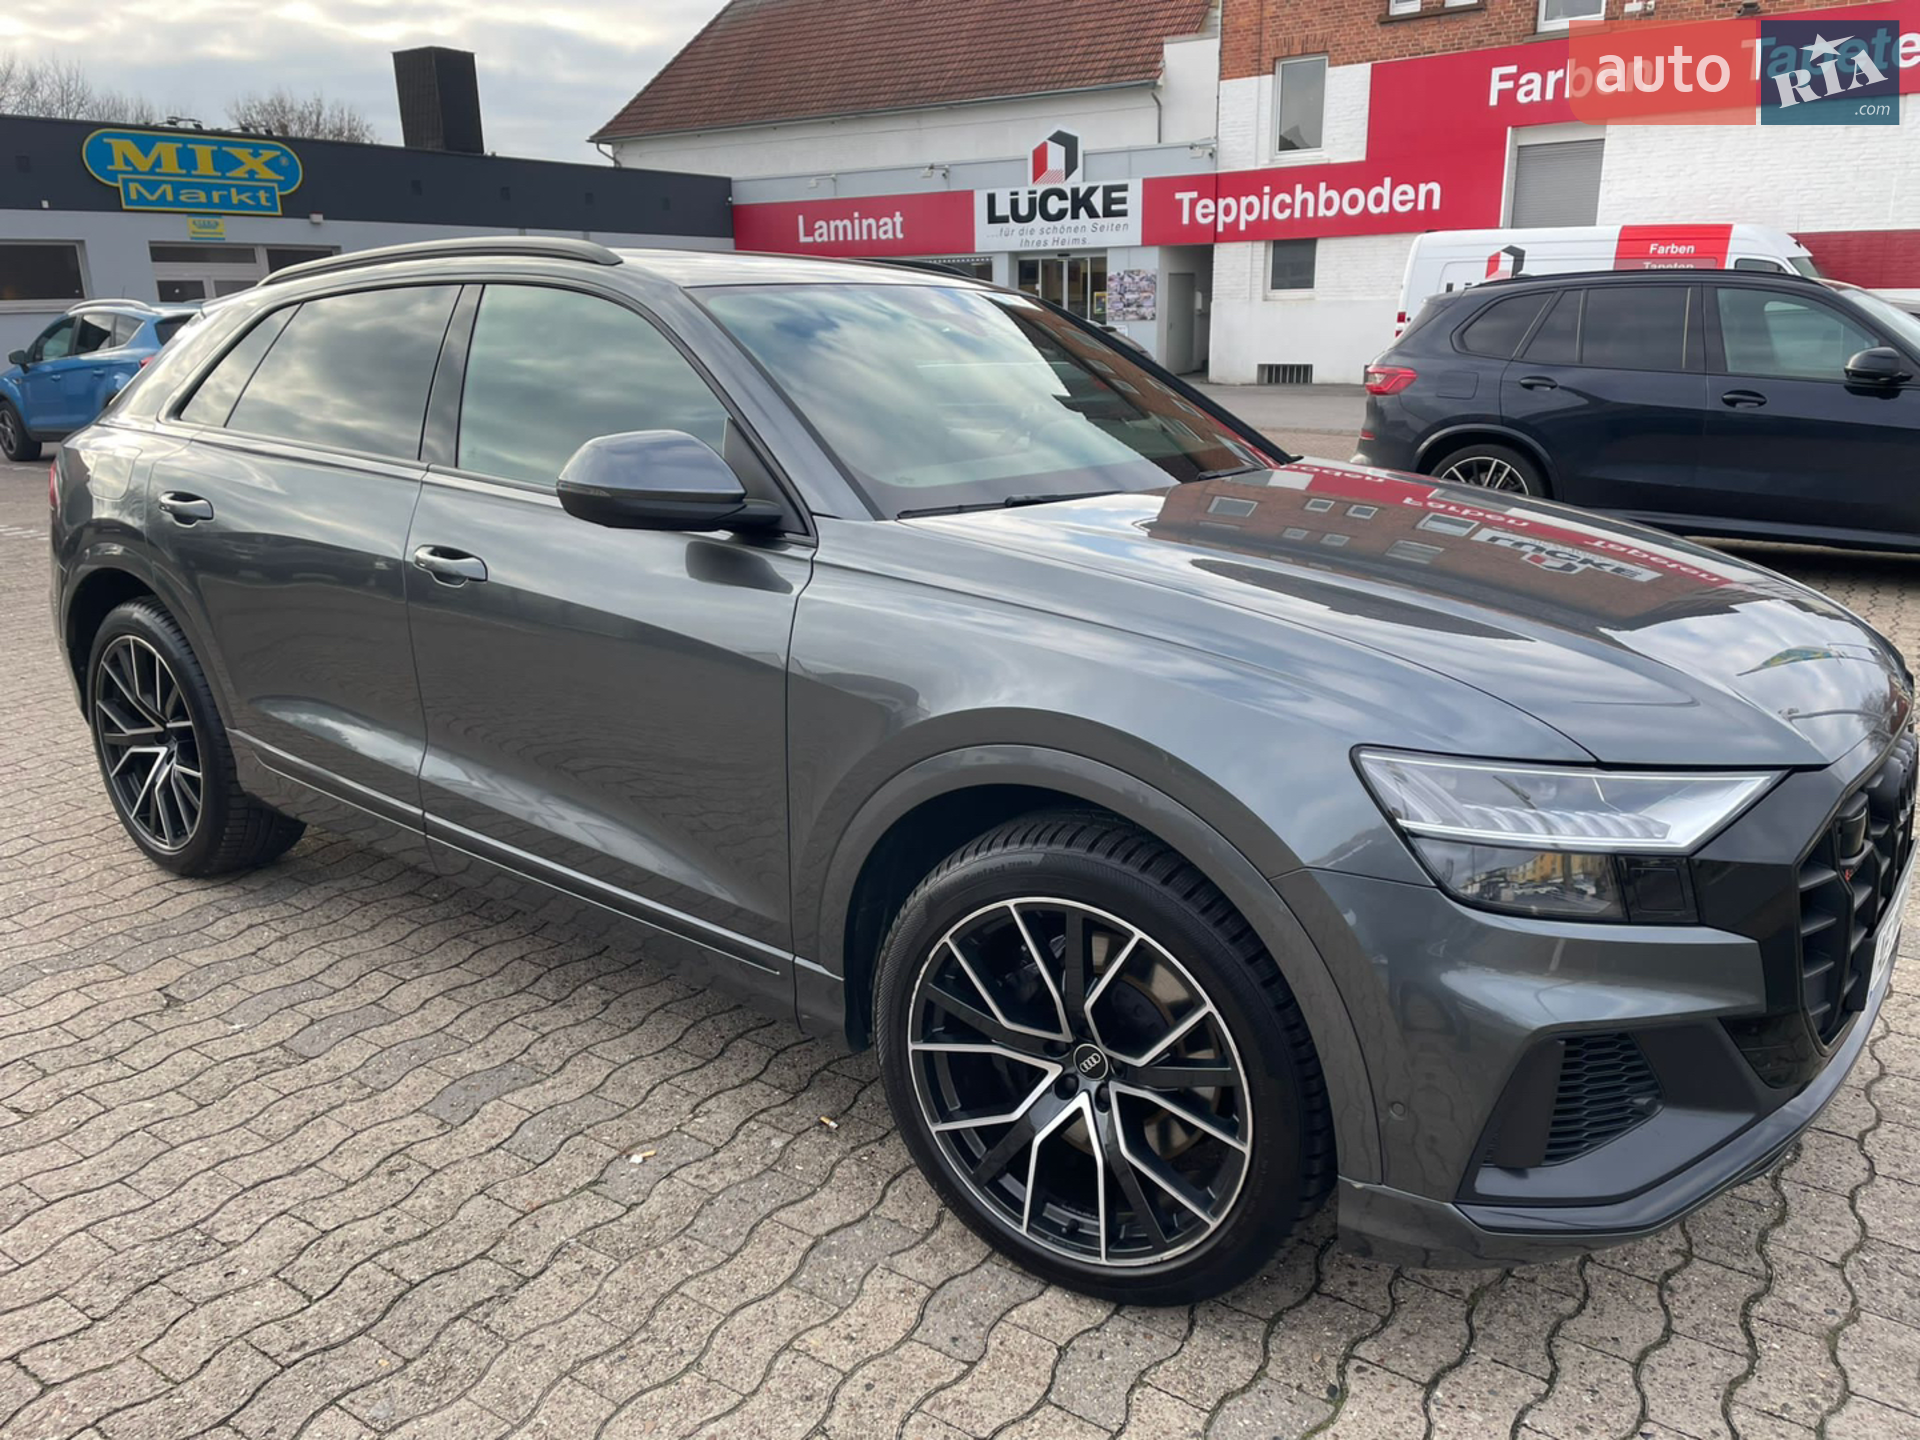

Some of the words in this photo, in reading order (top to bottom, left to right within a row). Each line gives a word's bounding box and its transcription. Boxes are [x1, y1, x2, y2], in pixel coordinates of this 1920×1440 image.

[103, 138, 285, 181] MIX
[128, 182, 272, 206] Markt
[986, 183, 1129, 225] LÜCKE
[1174, 176, 1441, 232] Teppichboden
[797, 211, 904, 243] Laminat
[1019, 226, 1036, 237] die
[1039, 224, 1087, 236] schönen
[1090, 221, 1129, 233] Seiten
[1019, 238, 1049, 248] Ihres
[1649, 242, 1695, 254] Farben
